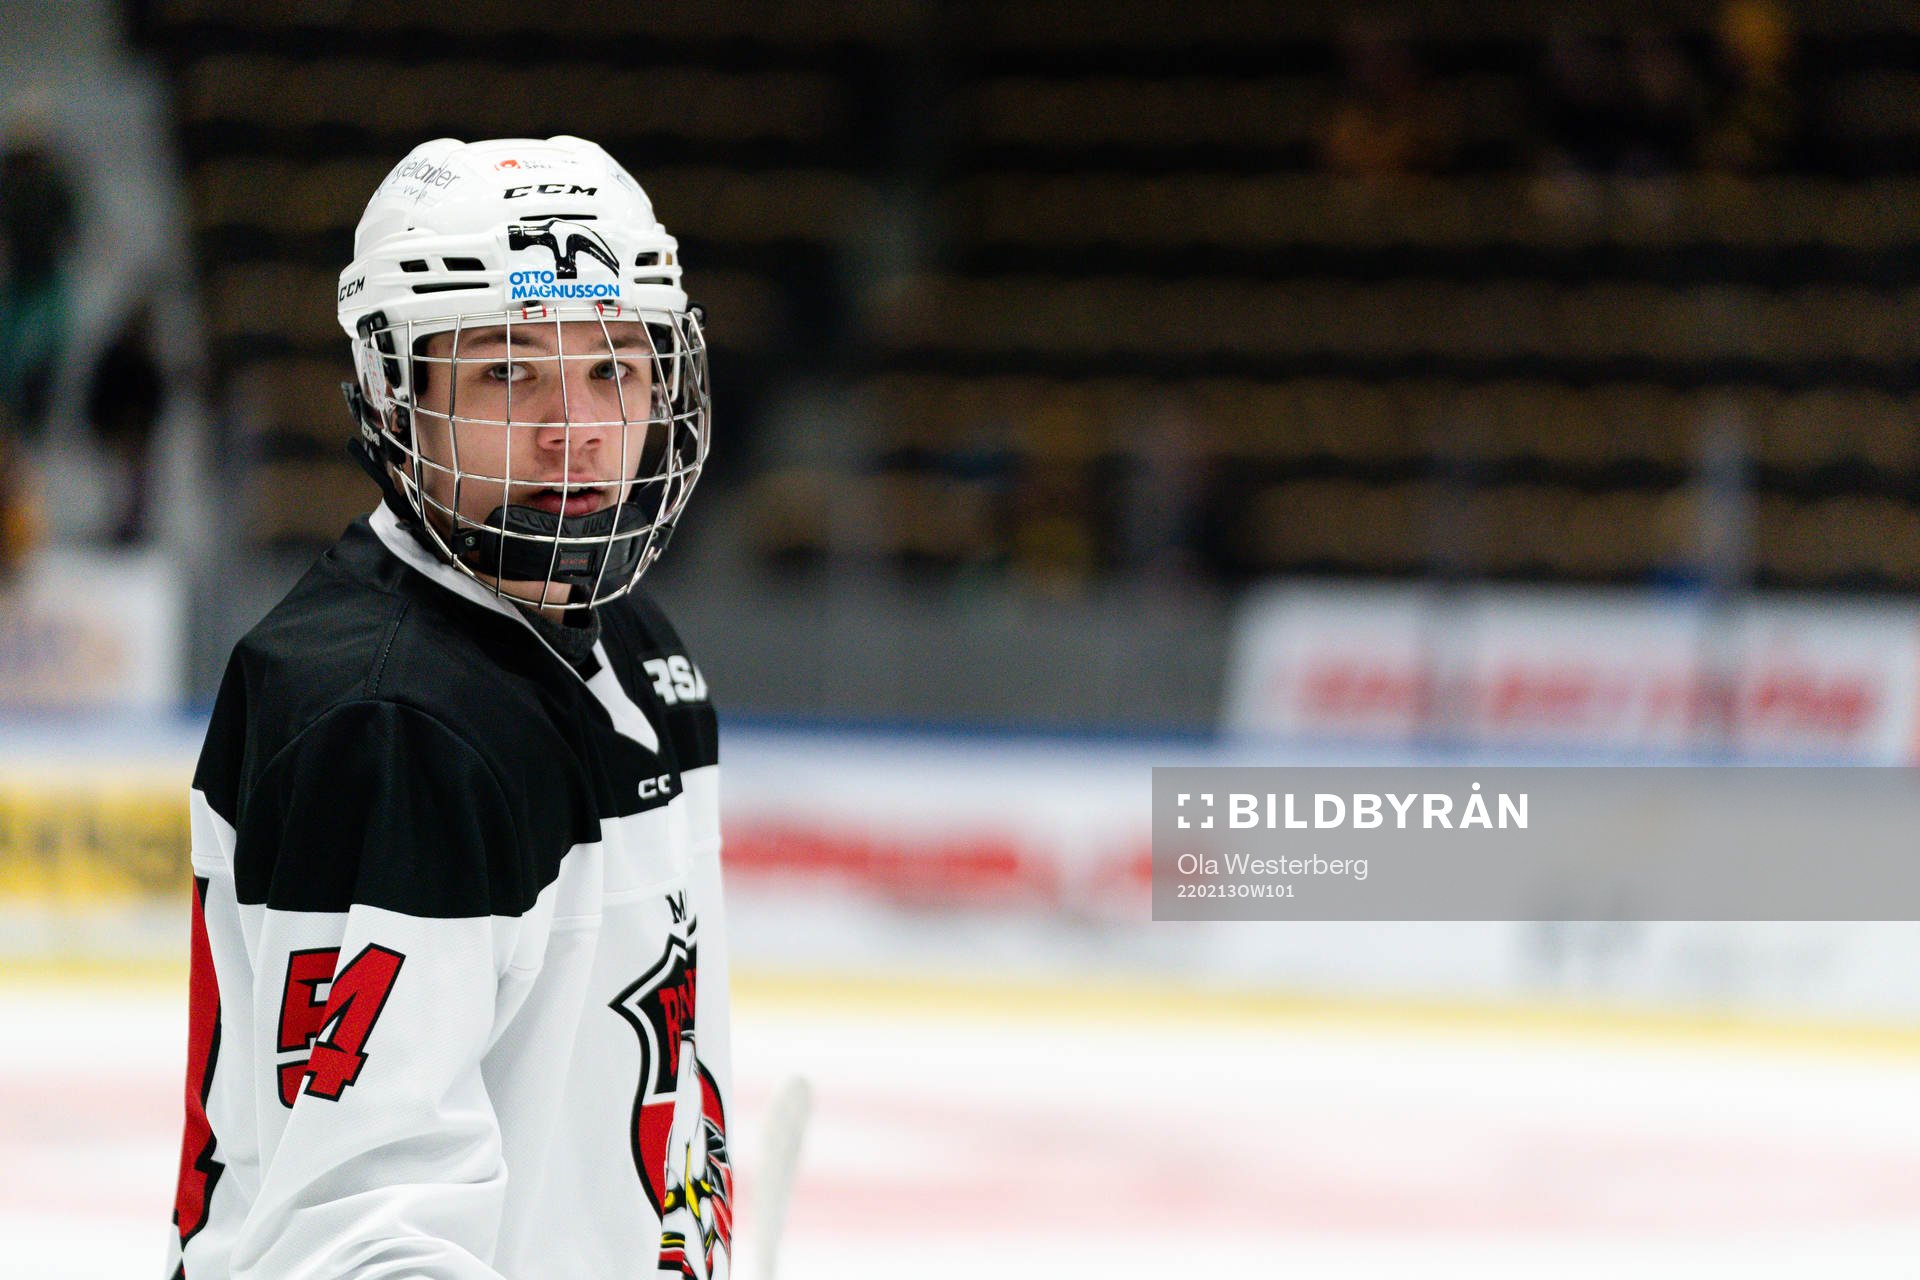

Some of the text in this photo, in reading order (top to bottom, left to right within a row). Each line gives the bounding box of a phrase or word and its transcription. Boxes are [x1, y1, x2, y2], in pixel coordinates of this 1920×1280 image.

[504, 184, 598, 199] CCM
[509, 270, 555, 285] OTTO
[339, 276, 365, 302] CCM
[511, 284, 620, 299] MAGNUSSON
